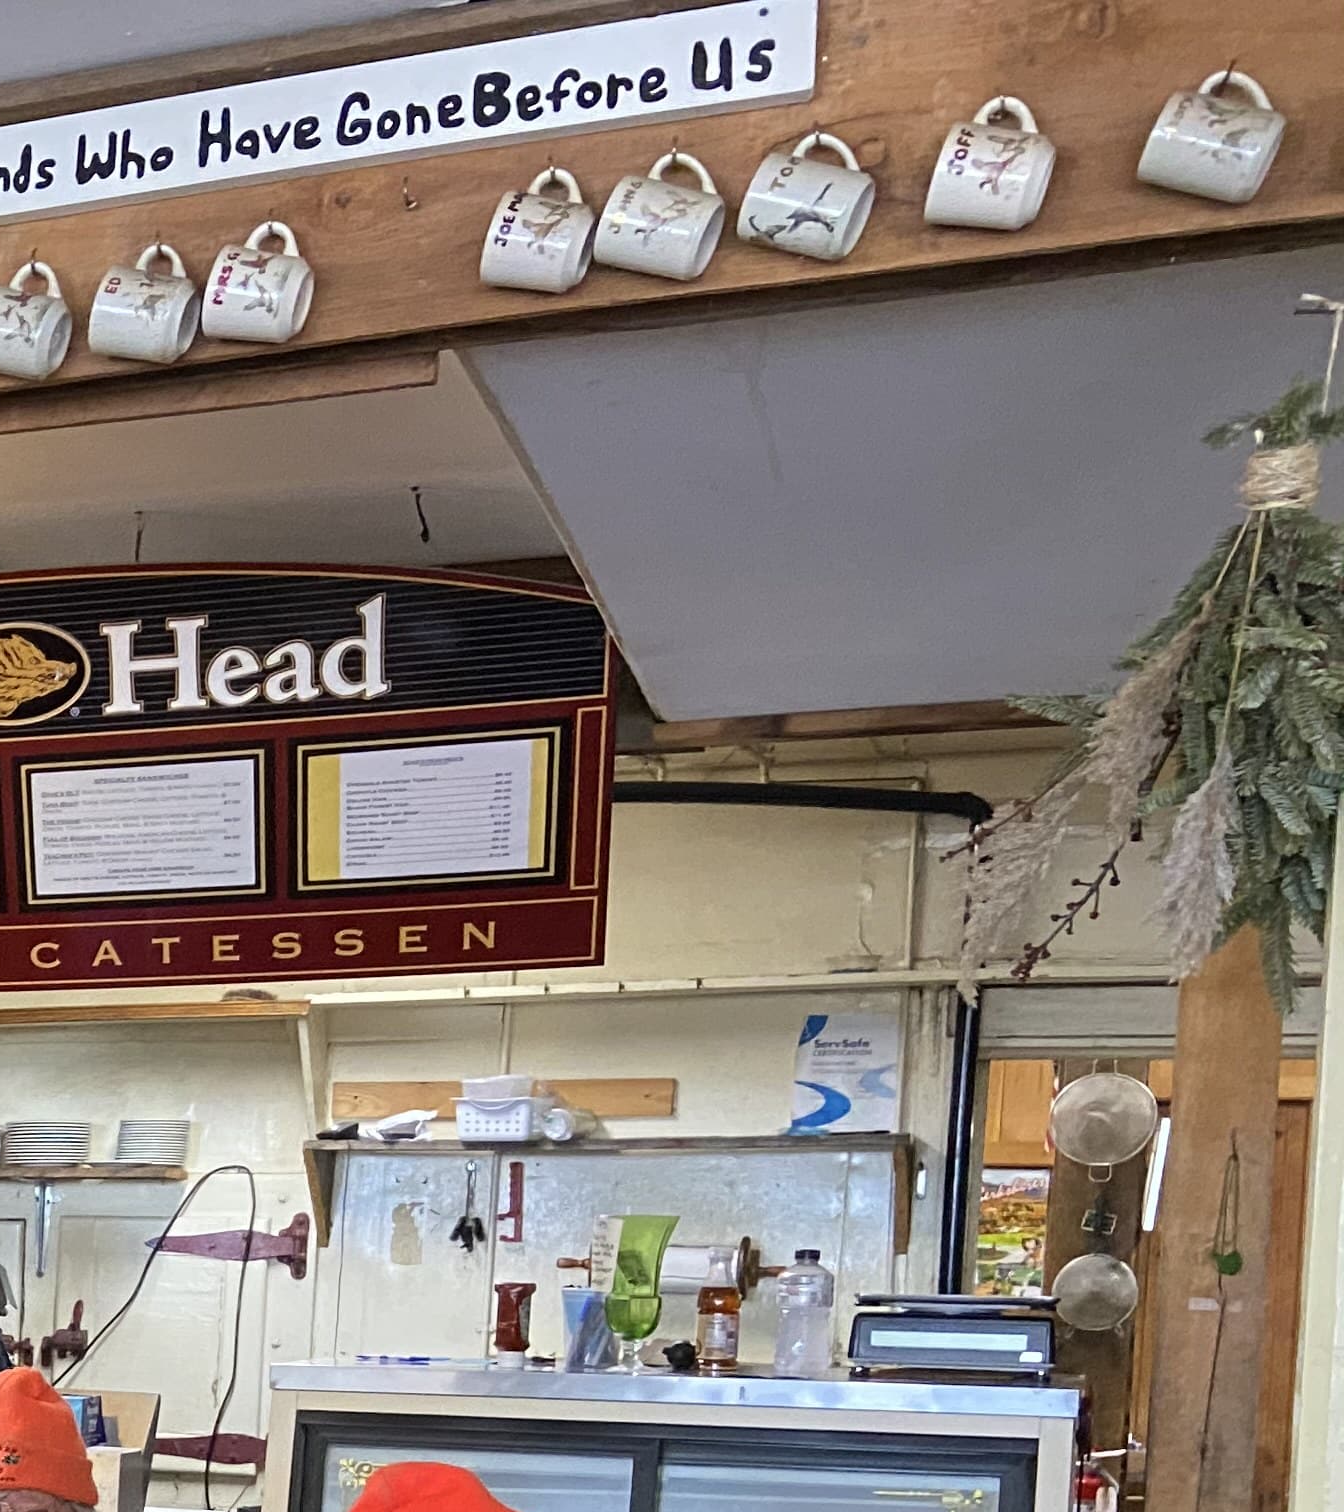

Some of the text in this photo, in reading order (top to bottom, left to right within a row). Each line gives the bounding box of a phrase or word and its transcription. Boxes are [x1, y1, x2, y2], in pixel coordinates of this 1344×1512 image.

[75, 128, 173, 185] Who
[197, 106, 322, 168] Have
[691, 37, 776, 92] Us
[104, 277, 122, 295] ED
[98, 594, 392, 718] Head
